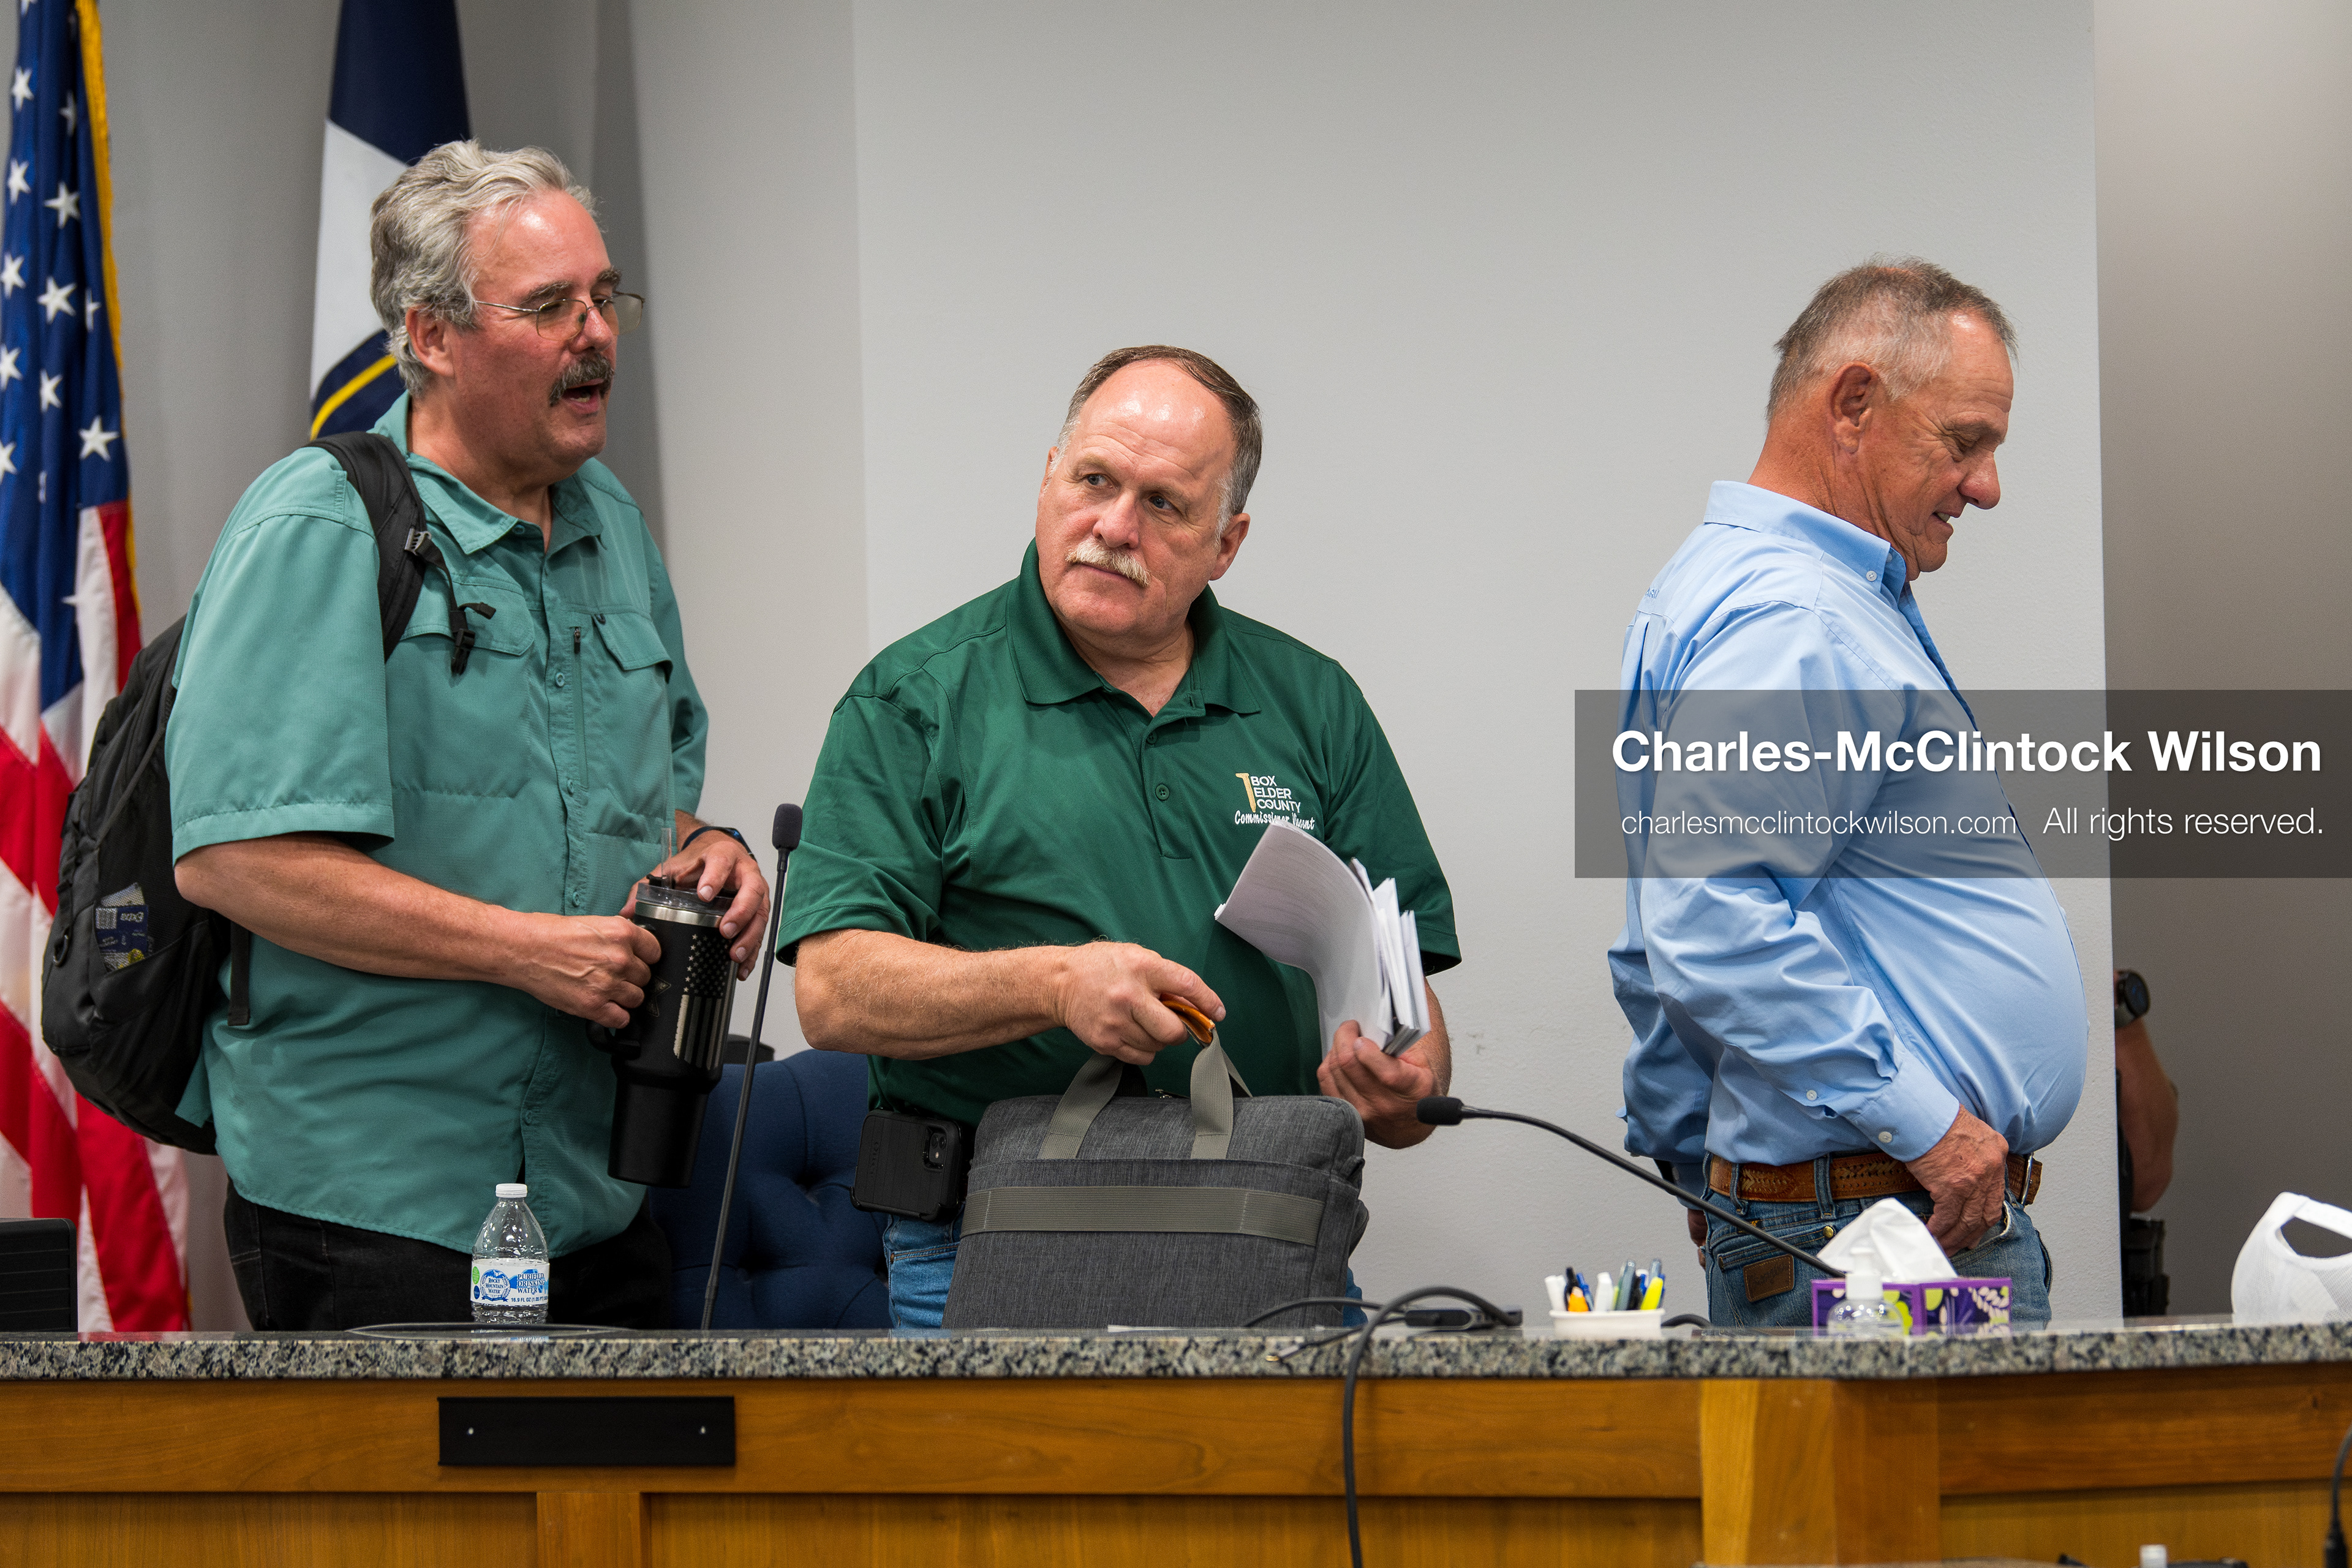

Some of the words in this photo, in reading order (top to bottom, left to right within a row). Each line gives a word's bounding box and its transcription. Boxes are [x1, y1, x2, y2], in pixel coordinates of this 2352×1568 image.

[1251, 775, 1277, 786] BOX
[1253, 787, 1292, 799] ELDER
[1257, 799, 1301, 813] COUNTY
